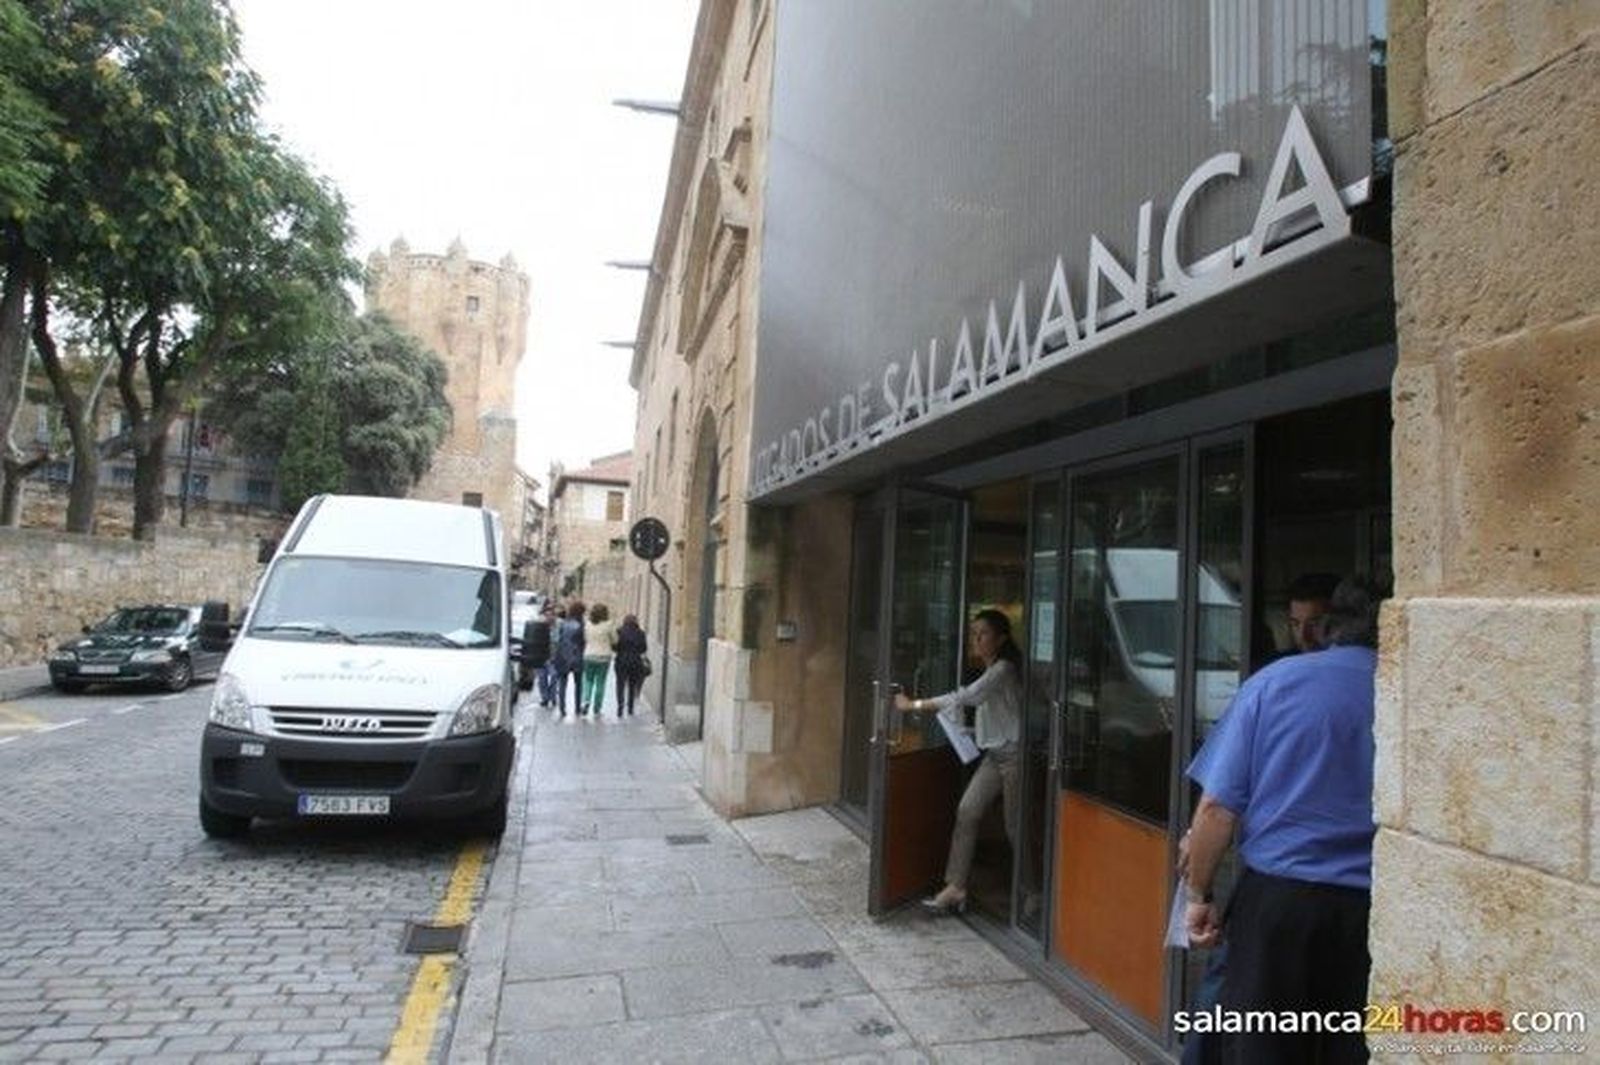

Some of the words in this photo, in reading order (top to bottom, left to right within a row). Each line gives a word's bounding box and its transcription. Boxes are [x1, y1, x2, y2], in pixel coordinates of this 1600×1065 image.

[838, 381, 871, 443] DE
[882, 104, 1352, 430] SALAMANCA
[321, 715, 382, 733] IVECO
